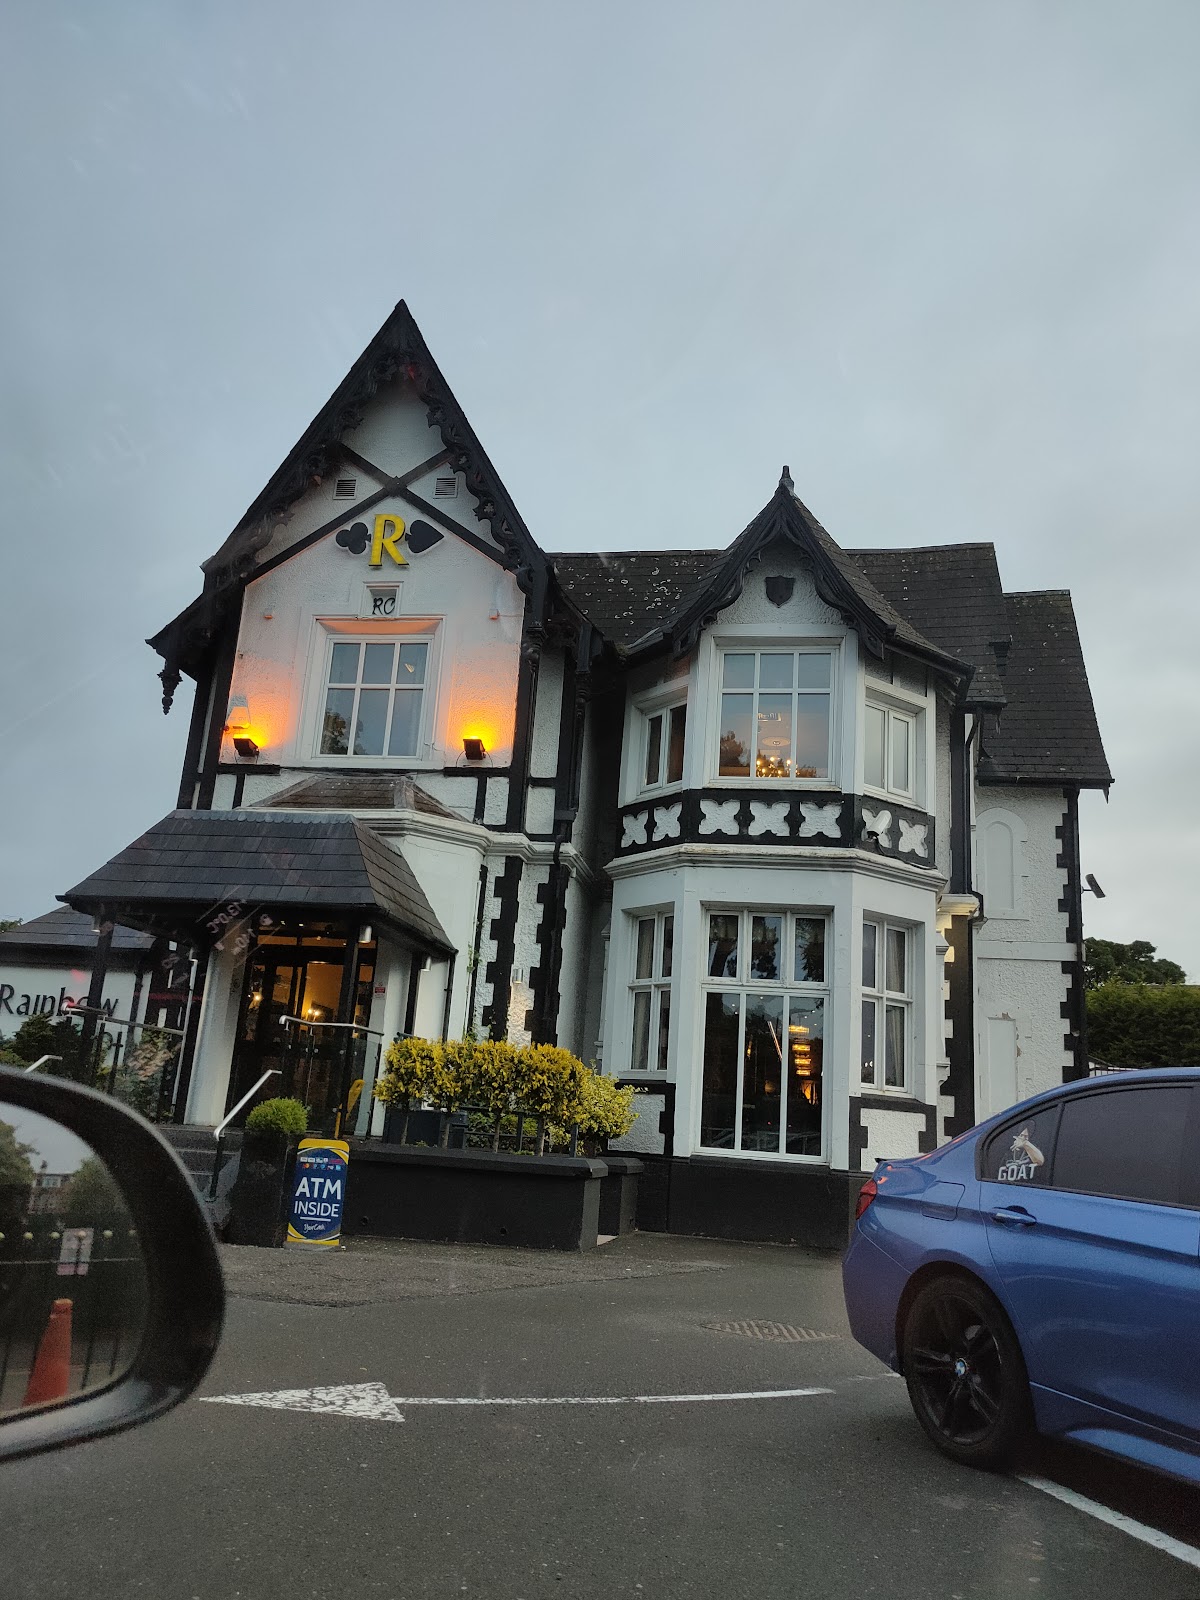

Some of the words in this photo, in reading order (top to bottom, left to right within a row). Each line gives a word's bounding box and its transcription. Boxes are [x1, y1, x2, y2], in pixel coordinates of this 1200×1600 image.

[368, 513, 410, 566] R
[998, 1163, 1038, 1181] GOAT
[294, 1176, 342, 1200] ATM
[294, 1200, 340, 1217] INSIDE
